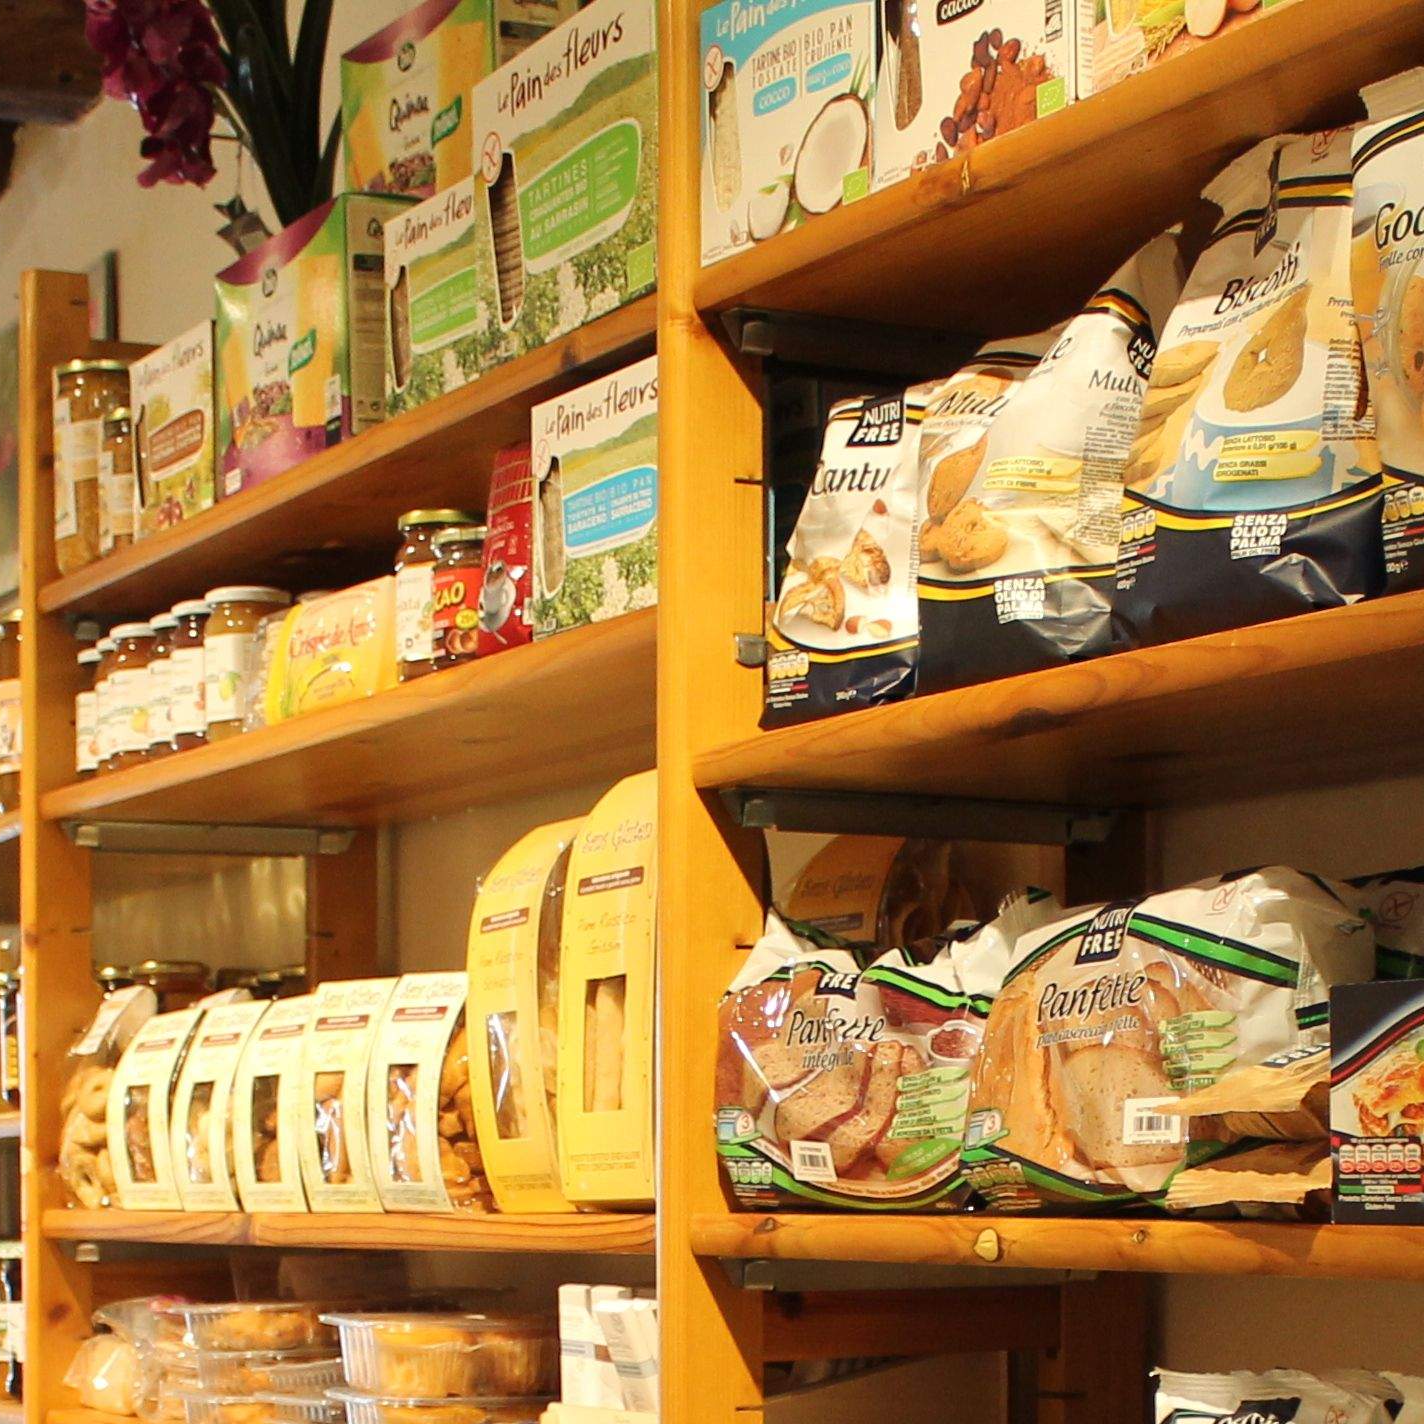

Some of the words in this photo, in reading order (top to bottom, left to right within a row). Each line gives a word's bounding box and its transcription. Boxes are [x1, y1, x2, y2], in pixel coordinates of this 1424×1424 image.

[829, 15, 854, 39] PAN
[511, 69, 543, 118] Pain
[544, 62, 562, 86] des
[563, 12, 625, 79] fleurs
[1214, 241, 1301, 316] Biscotti
[556, 404, 585, 440] Pain
[603, 378, 659, 419] fleurs
[862, 400, 901, 425] NUTRI
[853, 422, 900, 443] FREE
[1232, 525, 1266, 538] OLIO
[1268, 523, 1287, 536] DI
[1233, 514, 1288, 527] SENZA
[1230, 535, 1281, 550] PALMA
[994, 578, 1045, 592] SENZA
[995, 590, 1025, 604] OLIO
[1029, 588, 1045, 602] DI
[996, 600, 1044, 614] PALMA
[1081, 931, 1124, 957] FREE
[1037, 971, 1146, 1023] Panfette
